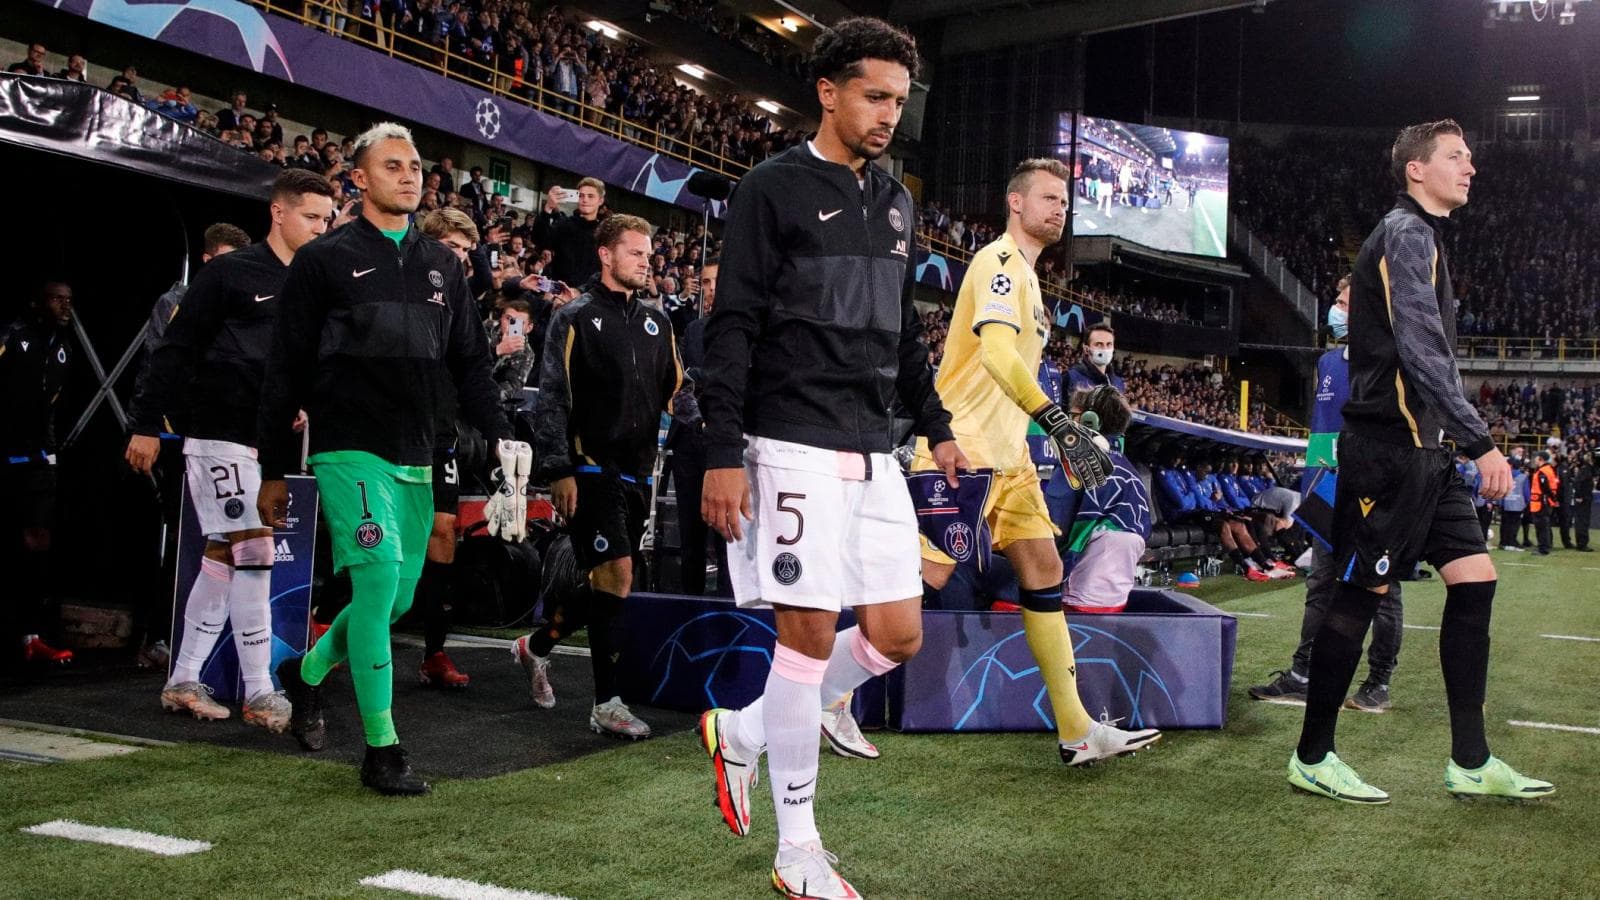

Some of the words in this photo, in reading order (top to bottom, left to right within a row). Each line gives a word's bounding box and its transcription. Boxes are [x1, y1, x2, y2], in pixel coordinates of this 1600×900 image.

[210, 463, 246, 499] 21
[356, 480, 373, 520] 1
[776, 491, 807, 546] 5
[947, 523, 969, 535] PARIS
